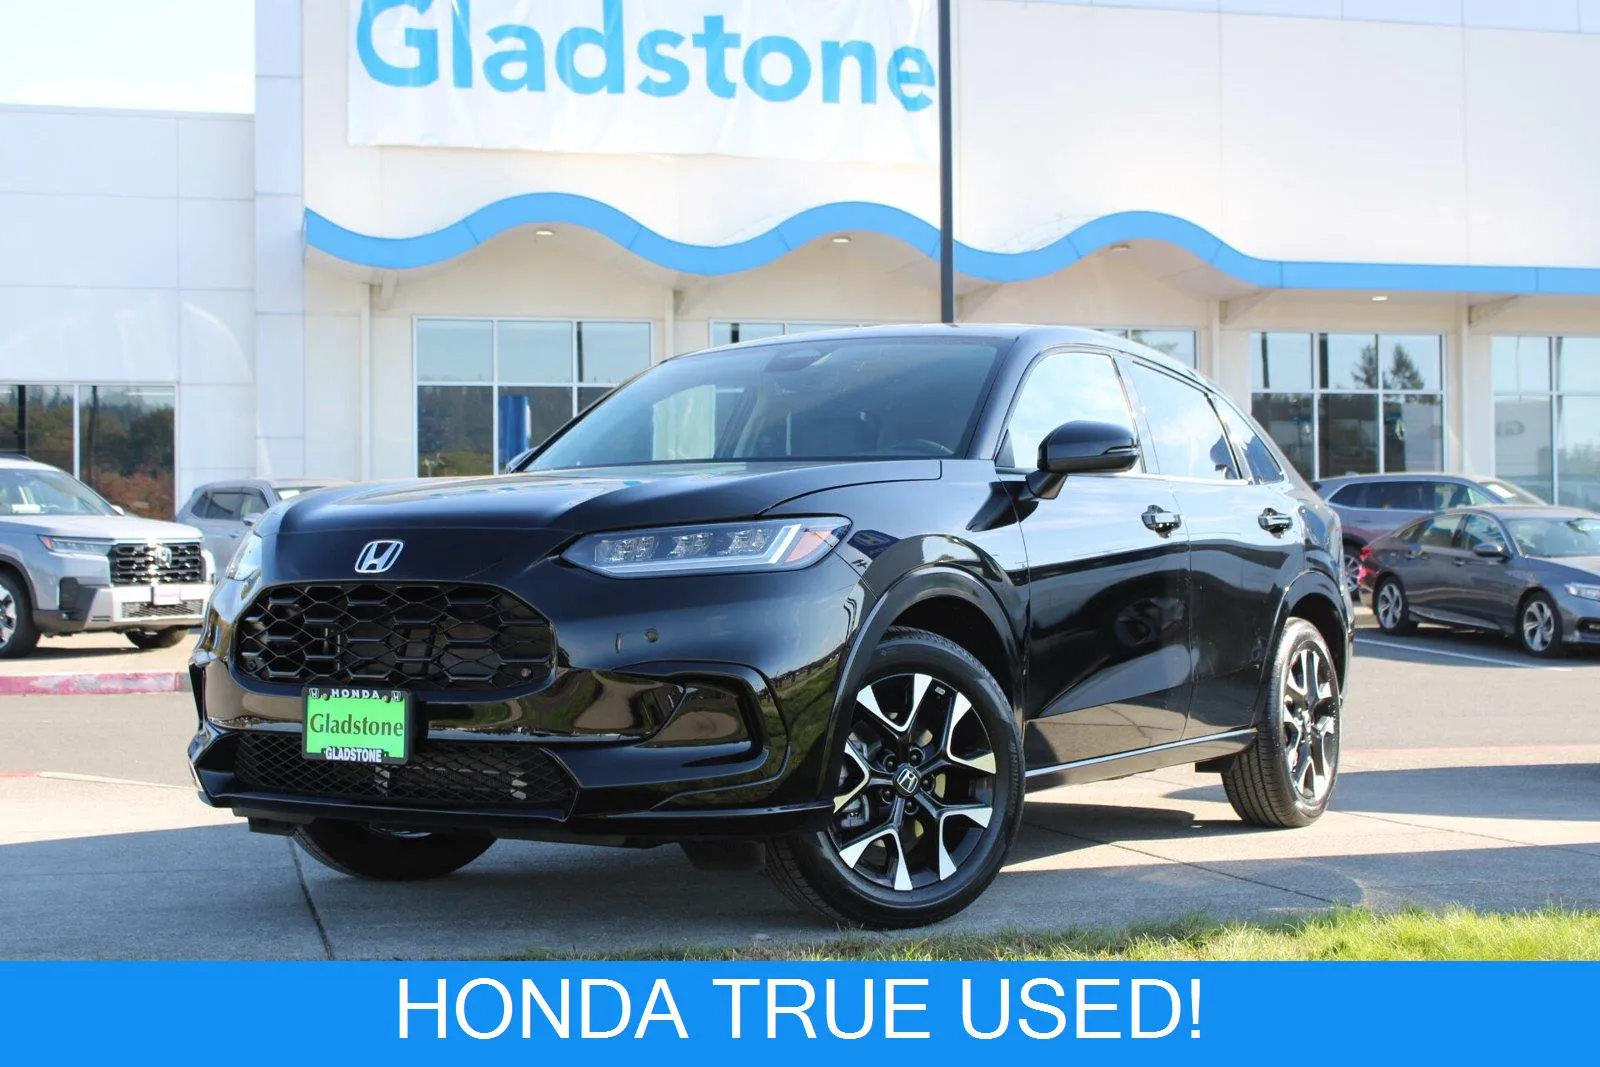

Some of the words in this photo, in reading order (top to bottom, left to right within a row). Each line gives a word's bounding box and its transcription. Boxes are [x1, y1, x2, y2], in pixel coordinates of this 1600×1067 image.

[356, 0, 936, 112] Gladstone
[331, 688, 380, 699] HONDA
[310, 713, 404, 736] Gladstone
[325, 746, 383, 763] GLADSTONE
